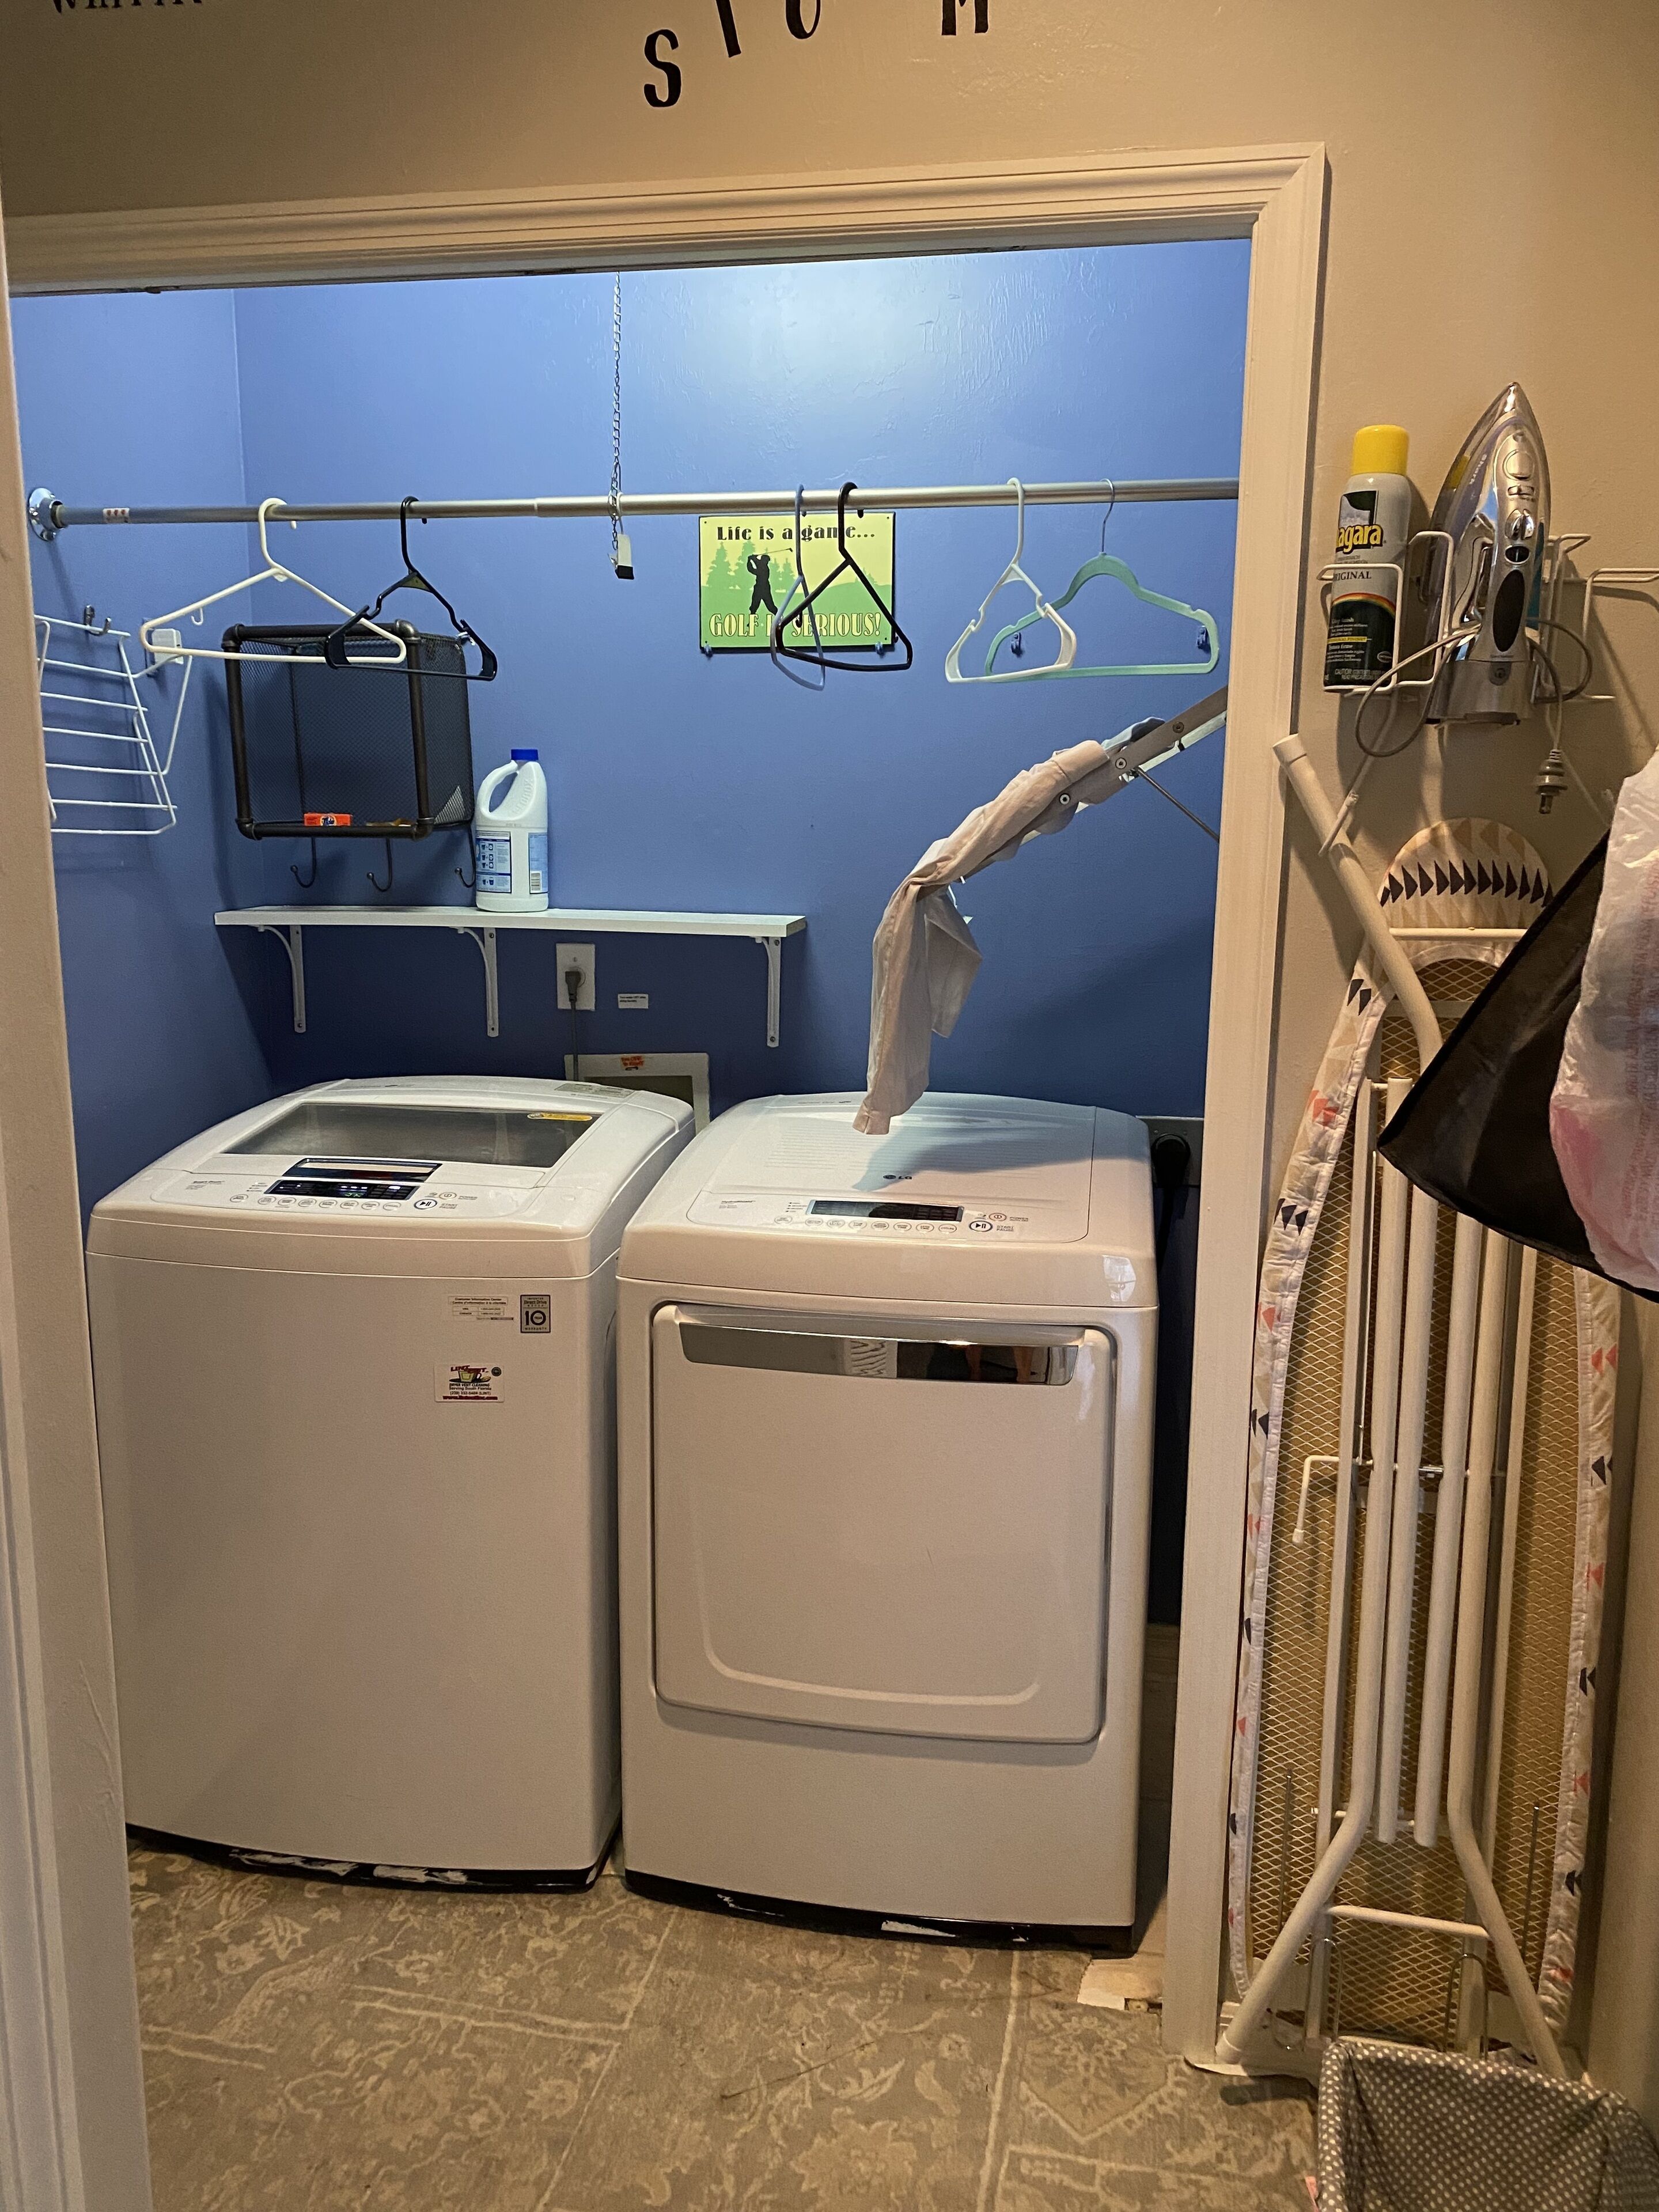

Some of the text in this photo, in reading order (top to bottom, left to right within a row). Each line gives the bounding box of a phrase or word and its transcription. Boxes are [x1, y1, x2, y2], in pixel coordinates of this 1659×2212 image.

[717, 527, 752, 540] Life
[759, 525, 774, 540] is
[782, 527, 793, 540] a
[709, 613, 759, 637] GOLF
[791, 612, 882, 637] SERIOUS!
[525, 1310, 547, 1326] 10
